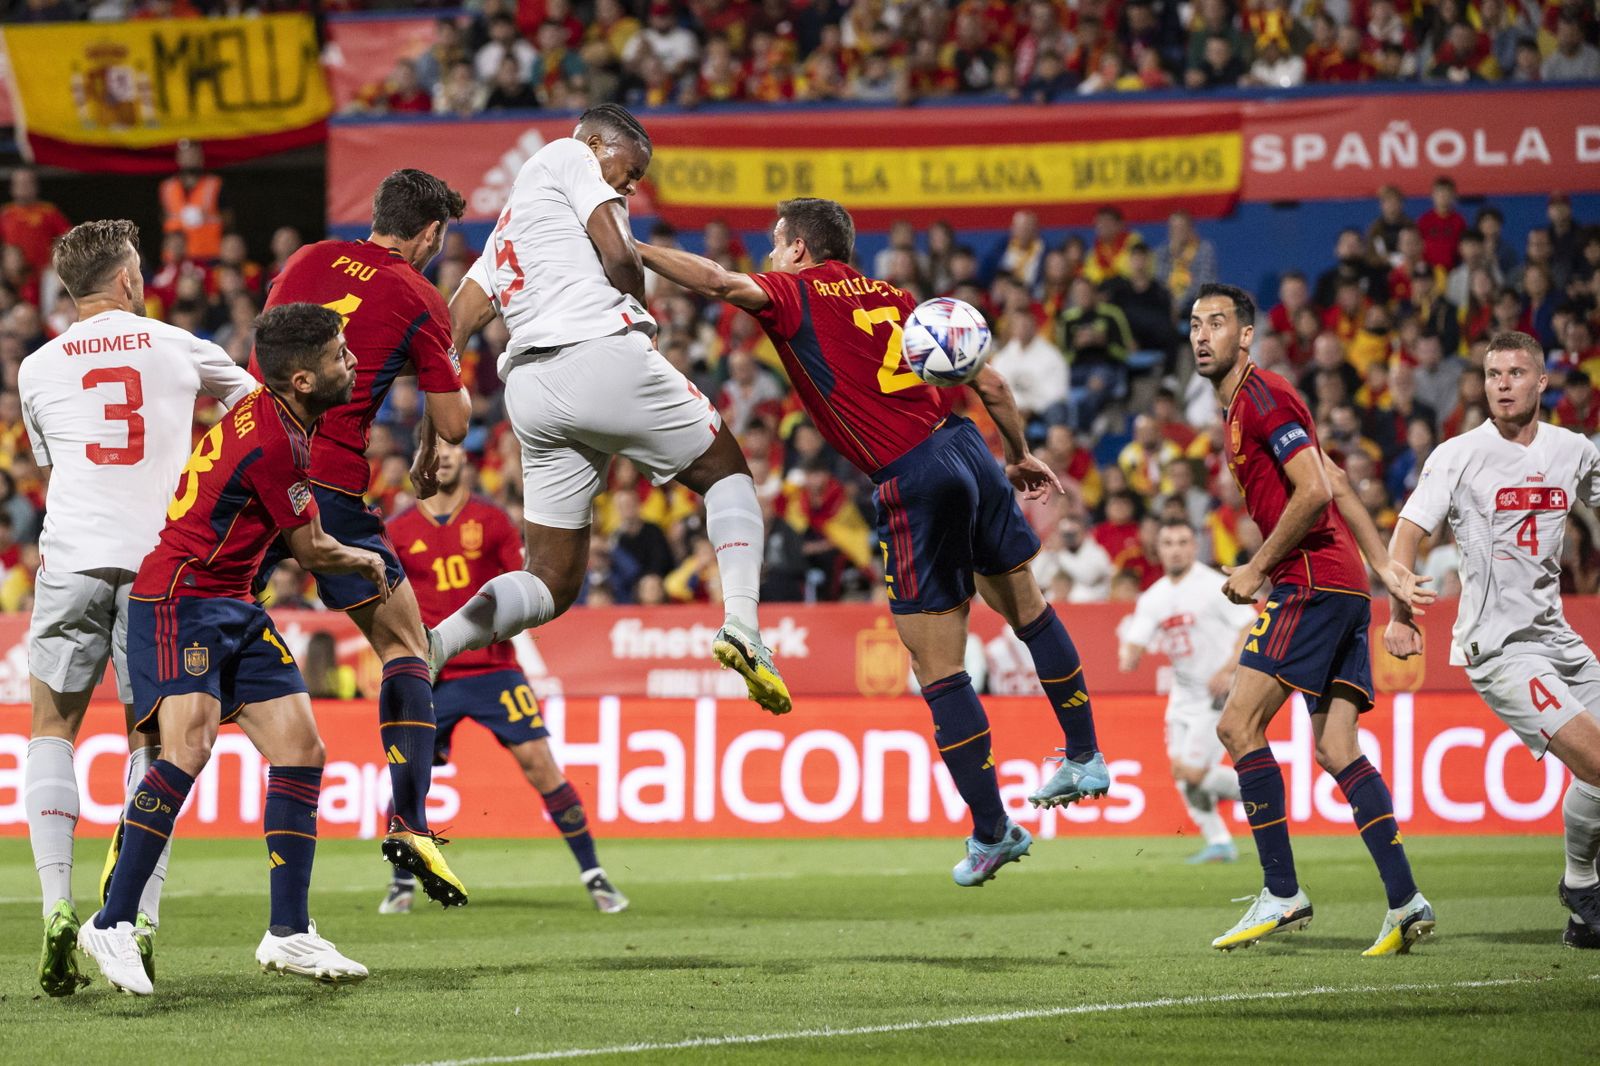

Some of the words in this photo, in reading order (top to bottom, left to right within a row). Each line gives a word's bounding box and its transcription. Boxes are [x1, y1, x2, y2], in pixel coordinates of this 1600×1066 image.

[1251, 120, 1552, 174] SPAÑOLA
[764, 160, 815, 194] DE
[842, 158, 889, 194] LA
[920, 155, 1044, 194] LLANA
[1072, 147, 1226, 188] BURGOS
[331, 255, 379, 282] PAU
[62, 332, 152, 356] WIDMER
[852, 305, 926, 394] 2
[82, 366, 145, 465] 3
[1516, 514, 1539, 556] 4
[431, 554, 471, 592] 10
[1250, 601, 1280, 637] 5
[499, 683, 540, 723] 10
[1529, 676, 1562, 712] 4
